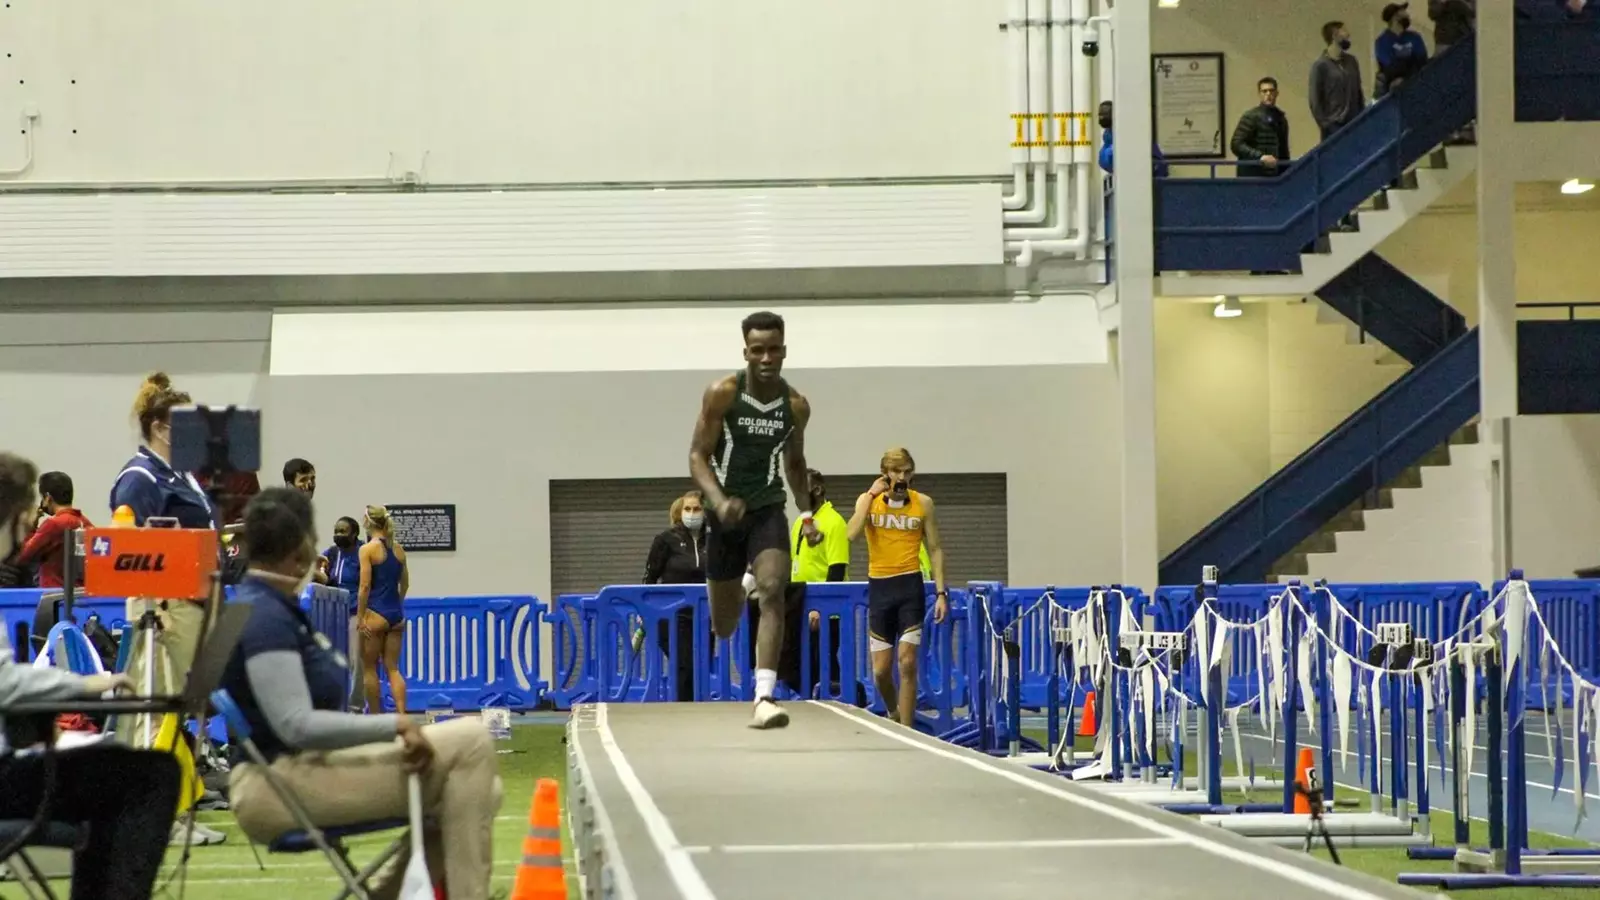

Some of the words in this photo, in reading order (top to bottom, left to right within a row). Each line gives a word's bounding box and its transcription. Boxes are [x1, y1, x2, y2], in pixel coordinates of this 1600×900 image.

[738, 416, 784, 429] COLORADO
[748, 425, 774, 436] STATE
[870, 513, 921, 530] UNC
[114, 553, 166, 571] GILL
